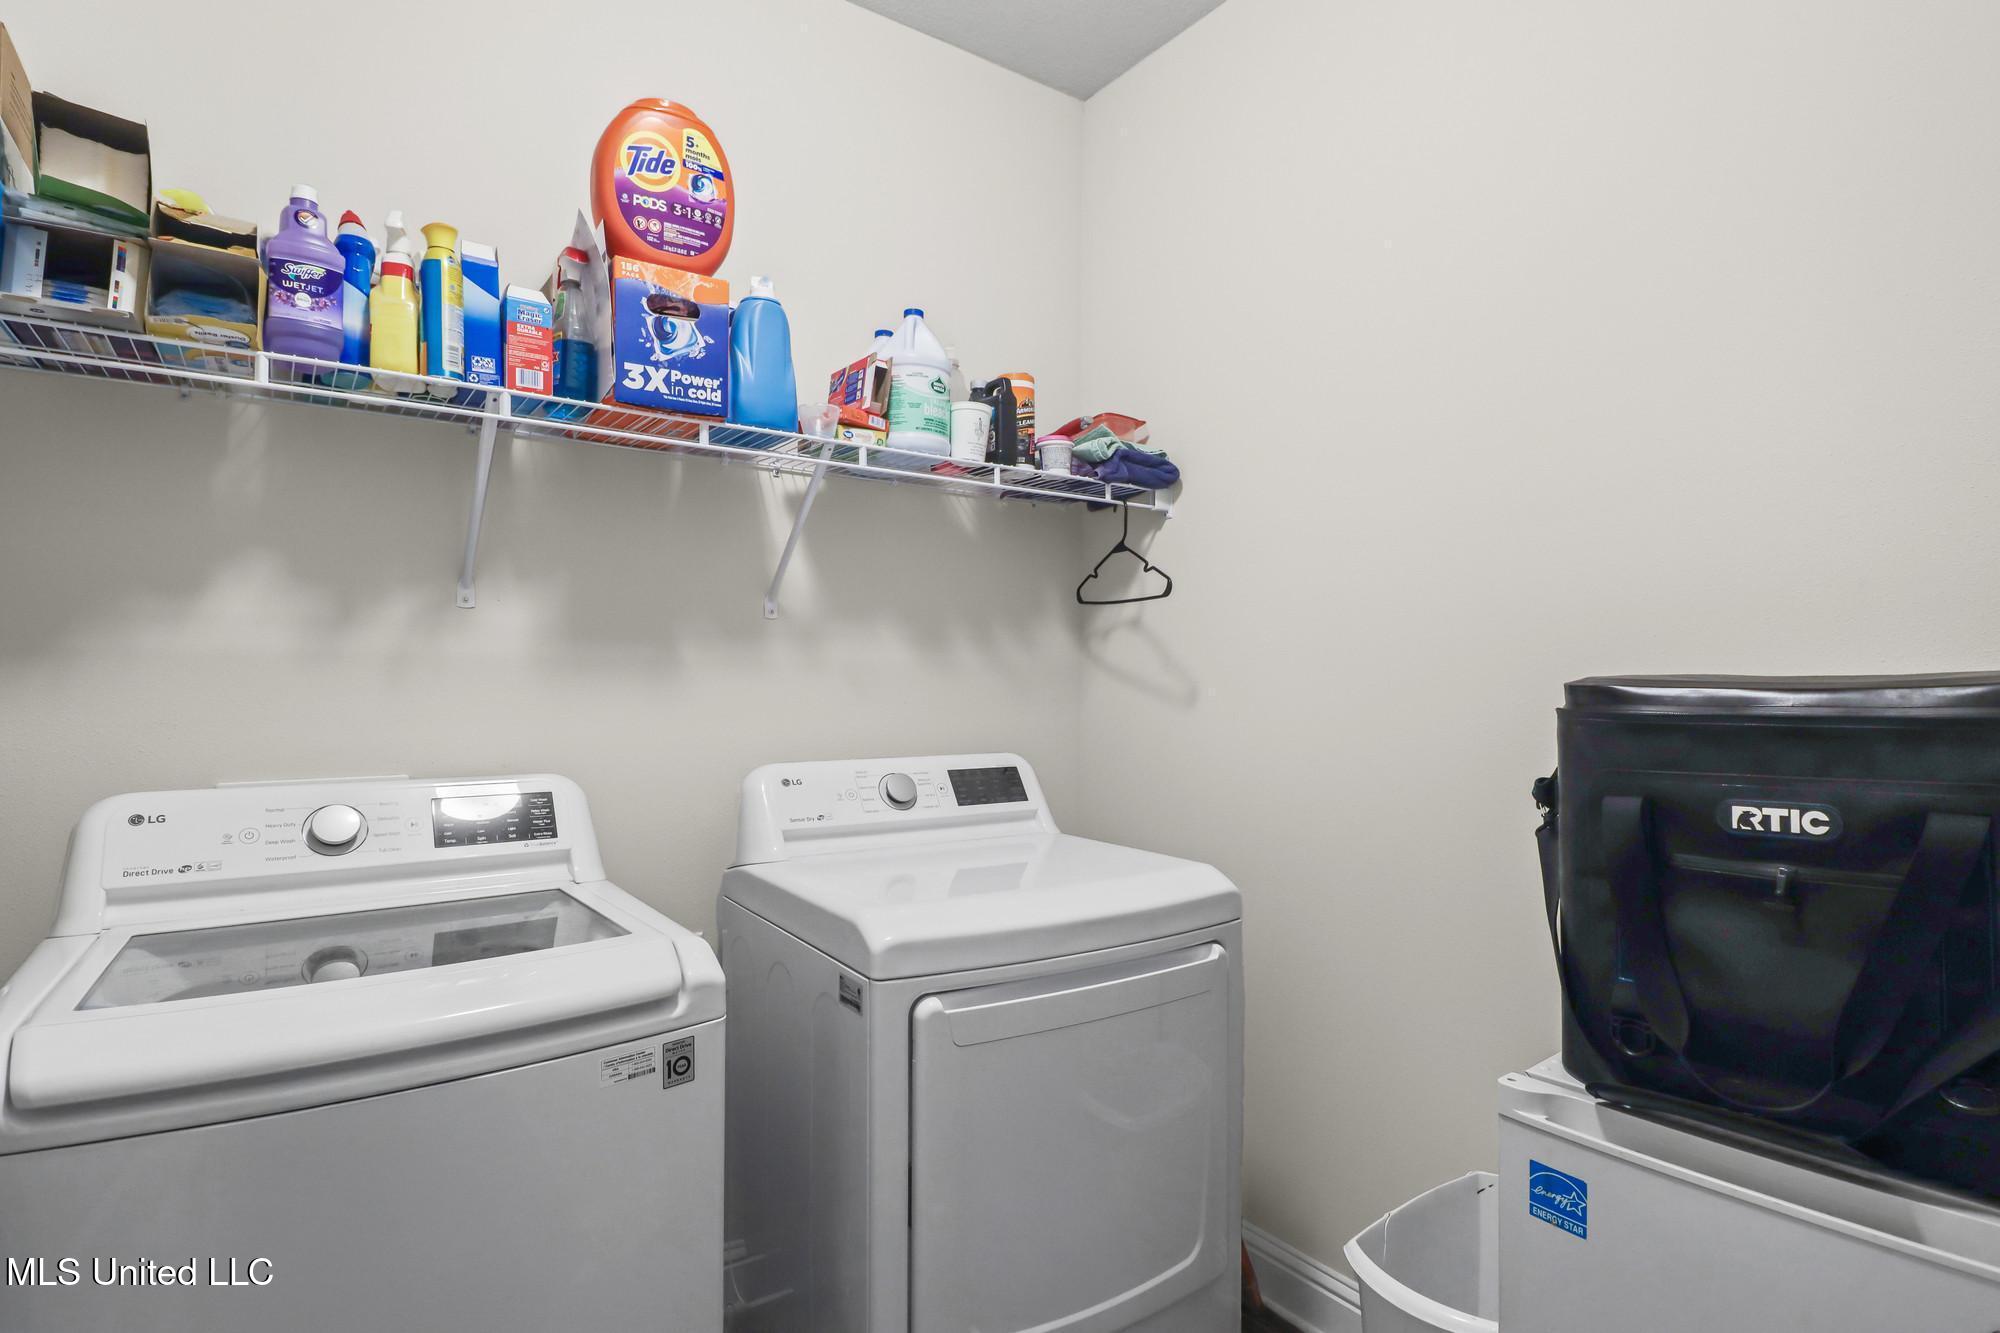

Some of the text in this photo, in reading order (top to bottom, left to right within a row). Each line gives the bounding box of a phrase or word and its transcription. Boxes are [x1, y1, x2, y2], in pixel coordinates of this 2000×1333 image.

[626, 145, 676, 176] Tide
[685, 148, 711, 161] months
[633, 194, 667, 212] PODS
[281, 262, 327, 280] Swiffer
[622, 361, 669, 395] 3X
[671, 383, 684, 397] in
[688, 386, 722, 403] cold
[791, 778, 802, 786] LG
[148, 814, 166, 824] LG
[1731, 805, 1830, 835] RTIC
[122, 867, 174, 877] Direct Drive
[667, 1055, 692, 1080] 10
[1532, 1206, 1584, 1235] ENERGY STAR
